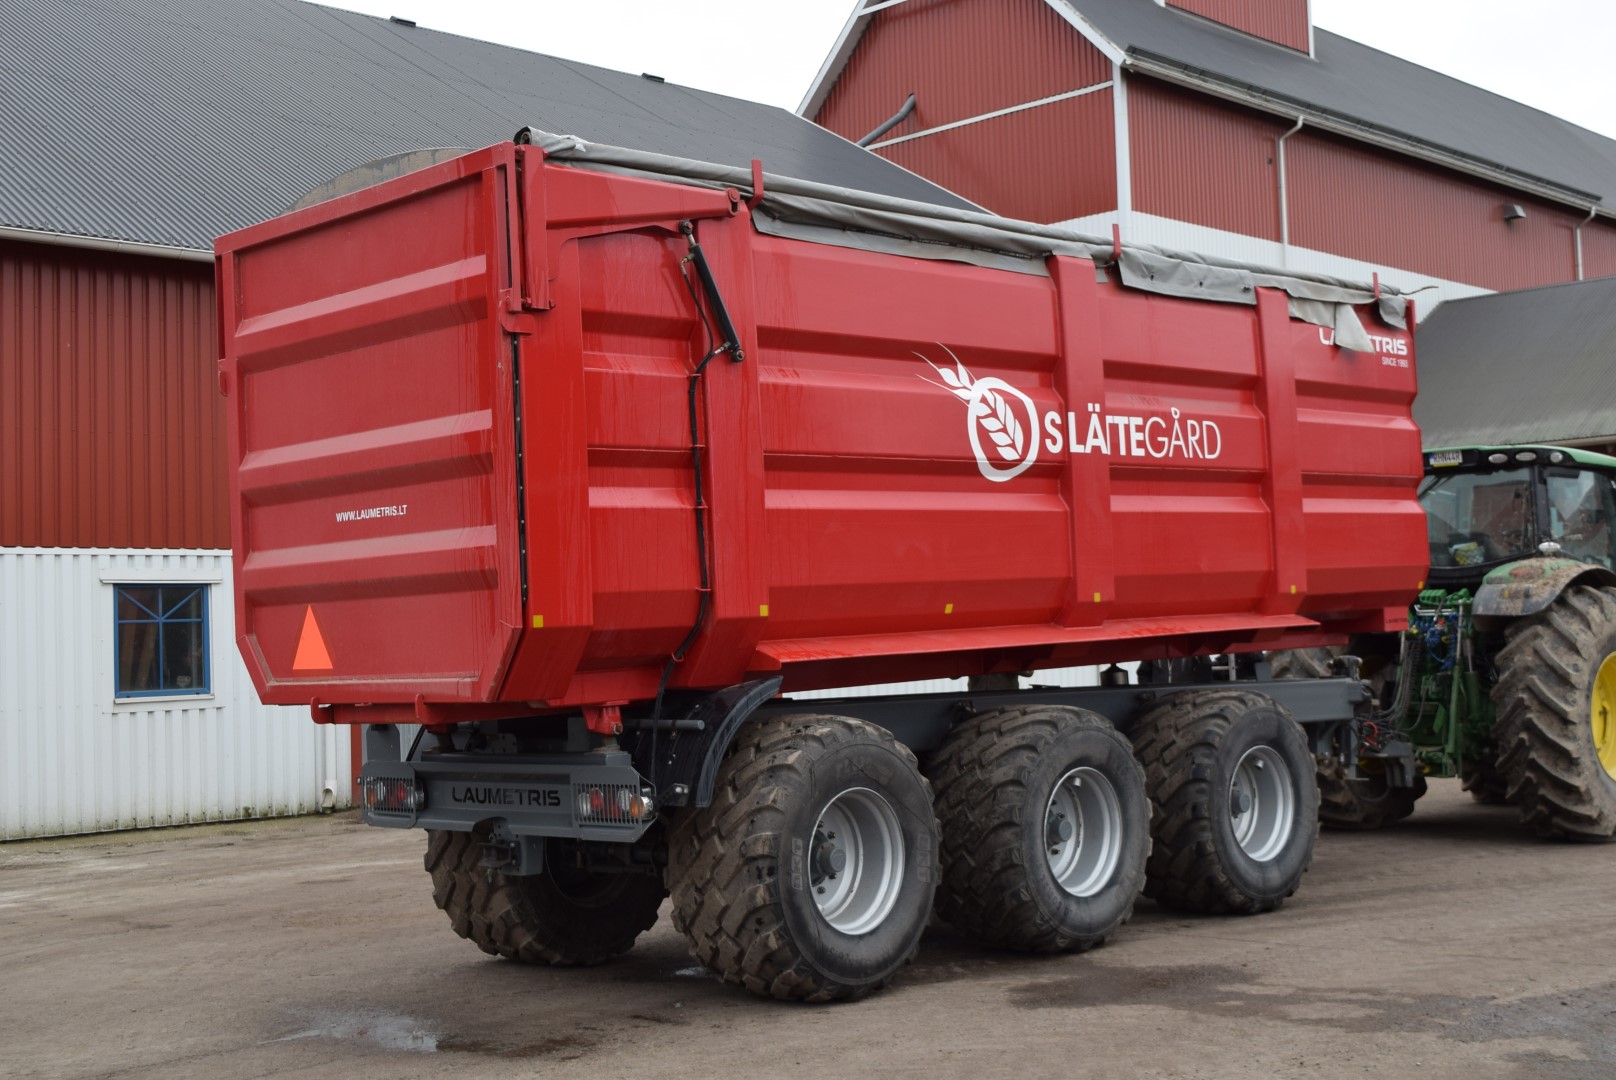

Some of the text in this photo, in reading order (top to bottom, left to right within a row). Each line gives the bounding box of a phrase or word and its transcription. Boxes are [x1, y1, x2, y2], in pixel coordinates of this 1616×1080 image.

[1382, 356, 1397, 367] SINCE
[1044, 403, 1222, 459] SLÄTTEGÅRD
[336, 504, 407, 522] WWW.LAUMETRIS.LT
[452, 787, 560, 806] LAUMETRIS
